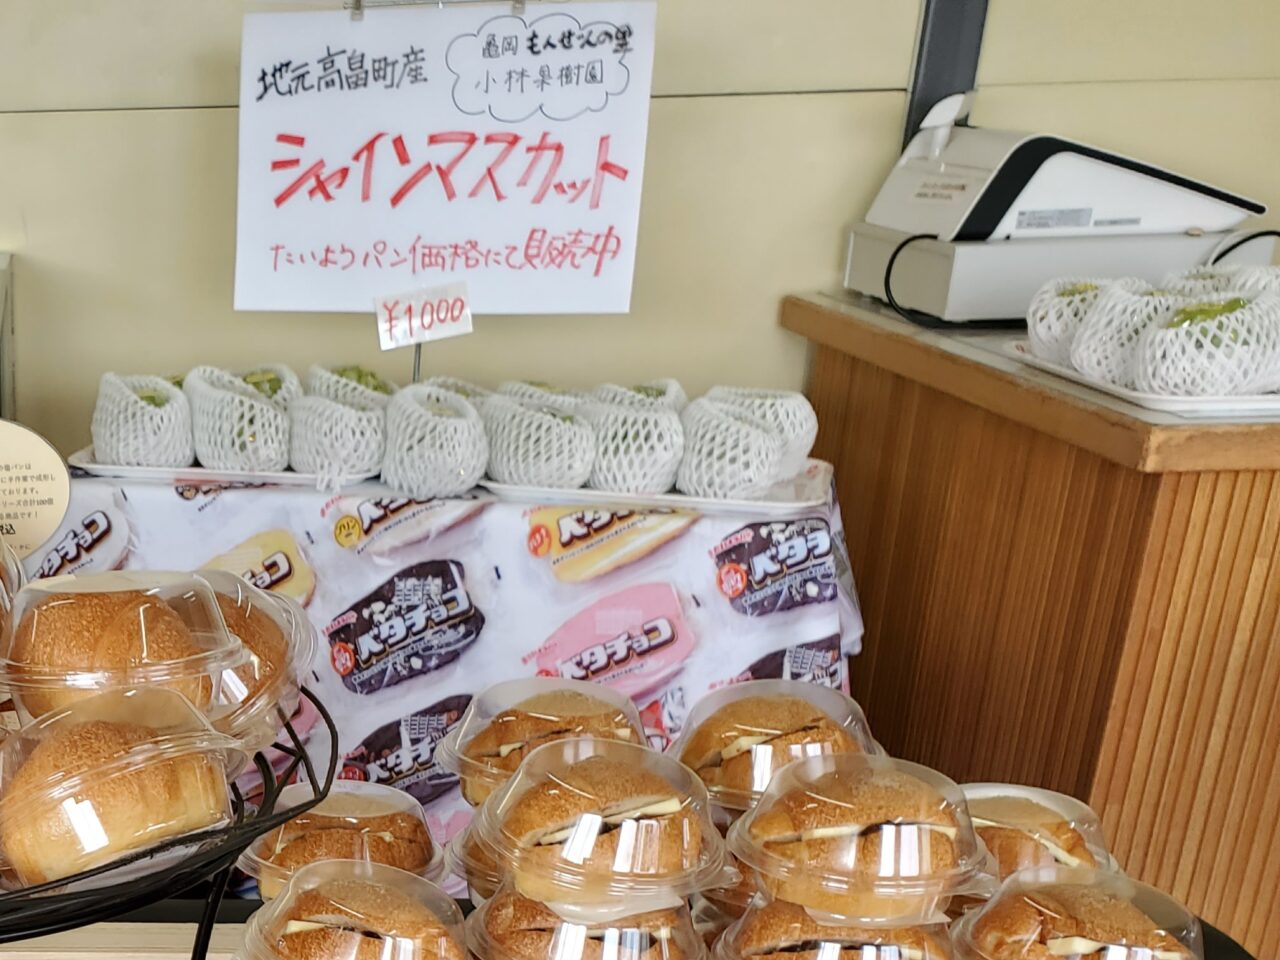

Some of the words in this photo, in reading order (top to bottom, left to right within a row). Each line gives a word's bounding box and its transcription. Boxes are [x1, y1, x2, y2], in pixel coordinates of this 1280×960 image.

[256, 45, 428, 101] 地元高畠町産
[475, 59, 603, 94] 小林果樹園
[271, 131, 629, 209] シャインマスカット
[269, 226, 621, 277] たいようパン価格にて販売中
